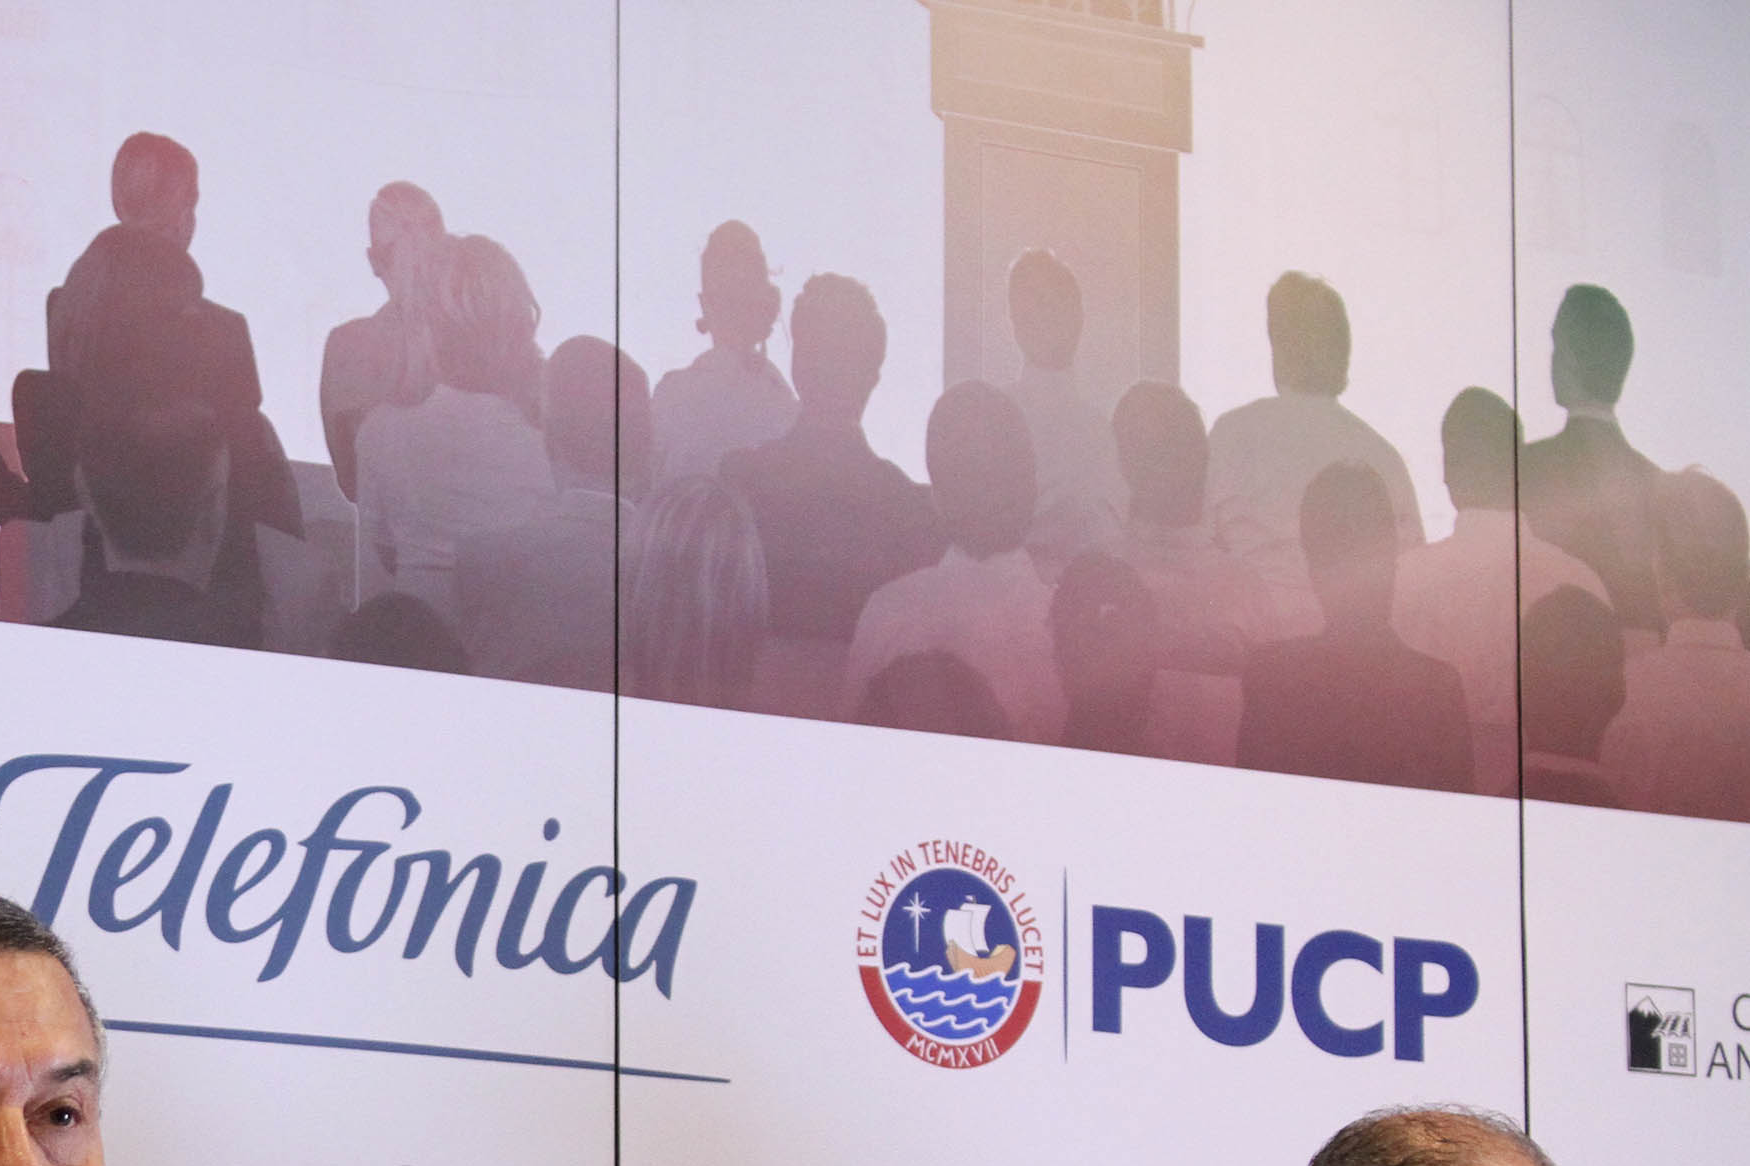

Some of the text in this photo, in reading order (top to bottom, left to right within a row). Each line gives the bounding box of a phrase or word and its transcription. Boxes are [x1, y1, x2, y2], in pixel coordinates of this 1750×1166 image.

[856, 839, 1044, 975] ET LUX IN TENEBRIS LUCET
[906, 1032, 1000, 1069] MCMXVII
[1092, 904, 1480, 1063] PUCP
